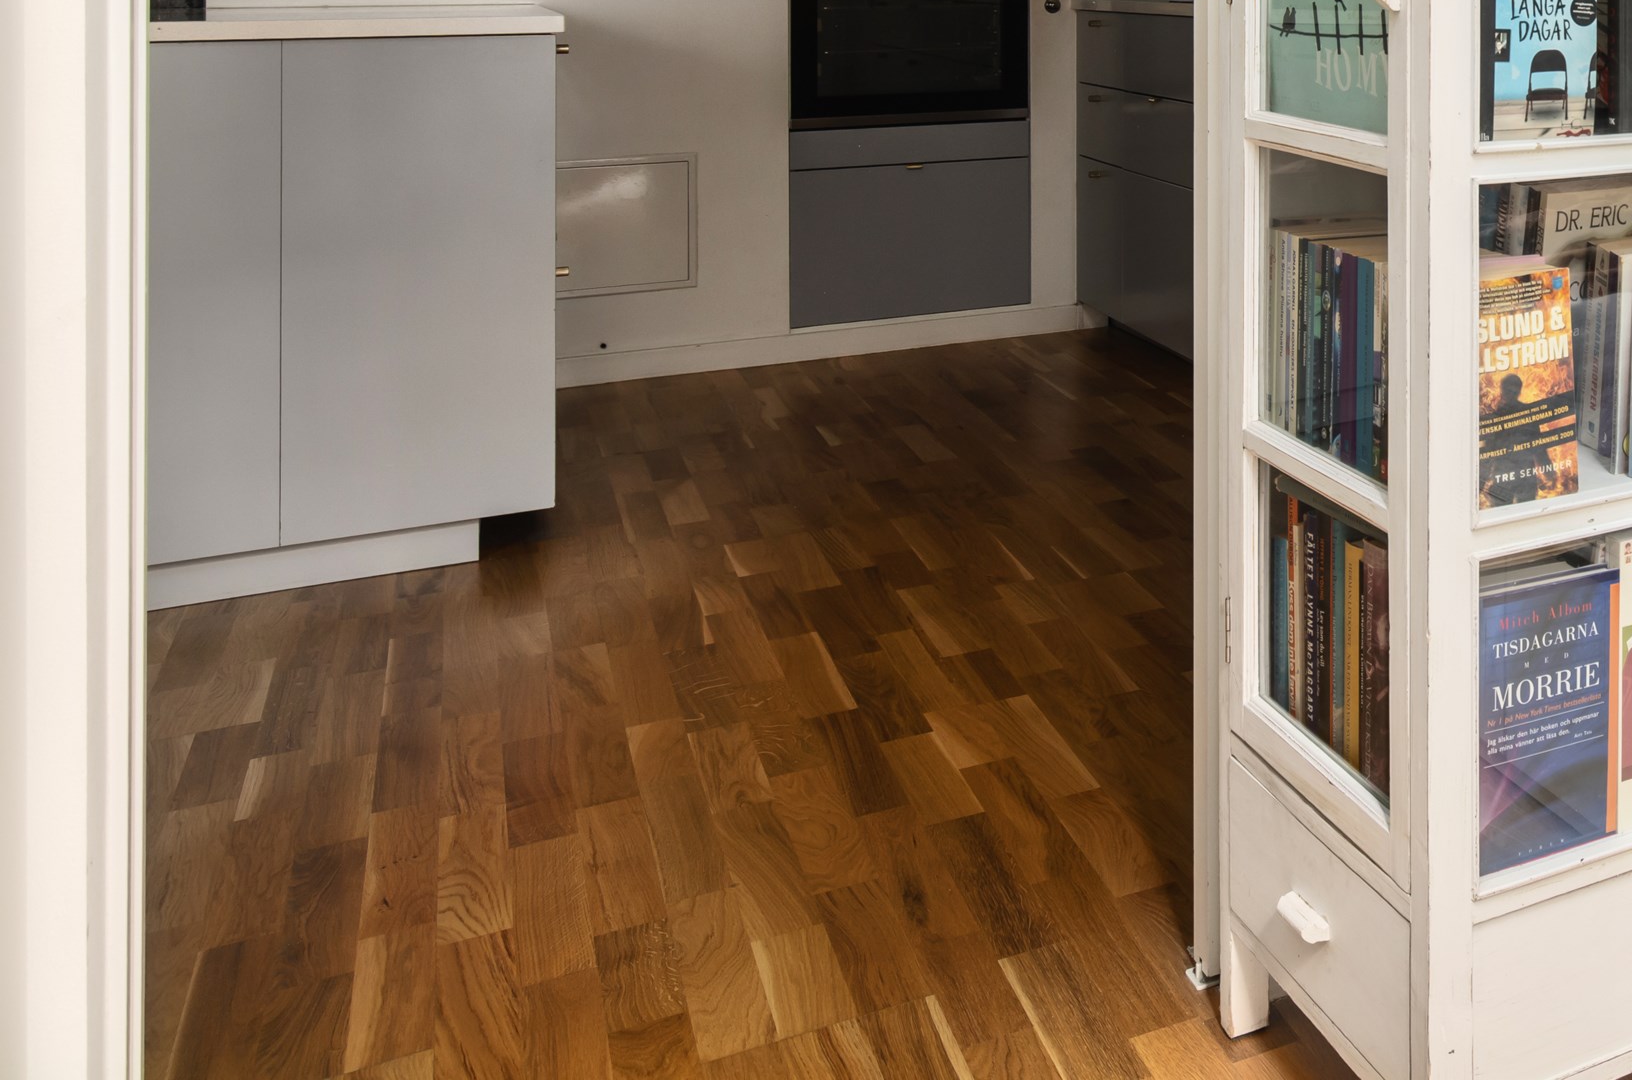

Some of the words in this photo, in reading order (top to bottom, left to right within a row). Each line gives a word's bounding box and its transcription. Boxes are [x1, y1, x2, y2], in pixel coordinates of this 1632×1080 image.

[1519, 18, 1572, 42] DAGAR
[1555, 209, 1583, 233] DR.
[1589, 203, 1629, 229] ERIC
[1479, 309, 1545, 345] SLUND
[1550, 305, 1566, 331] &
[1479, 333, 1569, 375] LSTRÖM
[1503, 410, 1553, 429] KRIMINALROMAN
[1554, 405, 1569, 415] 2009
[1479, 448, 1507, 460] ARPRISET
[1513, 442, 1531, 452] ÅRETS
[1532, 434, 1559, 447] SPÄNNING
[1560, 430, 1574, 439] 2009
[1494, 471, 1516, 483] TRE
[1519, 460, 1573, 478] SEKUNDER
[1307, 532, 1316, 580] FÄLTET
[1499, 610, 1540, 631] Mitch
[1550, 601, 1593, 619] Albom
[1492, 621, 1600, 660] TISDAGARNA
[1491, 661, 1601, 712] MORRIE
[1487, 719, 1496, 728] Nr
[1504, 715, 1514, 725] på
[1515, 712, 1529, 721] New
[1529, 708, 1543, 718] York
[1544, 704, 1562, 714] Times
[1563, 693, 1602, 709] bestsellerlista
[1487, 738, 1496, 748] Jag
[1498, 733, 1516, 744] älskar
[1516, 730, 1529, 739] den
[1529, 727, 1540, 736] här
[1540, 723, 1559, 733] boken
[1559, 718, 1571, 728] och
[1572, 711, 1600, 726] uppmanar
[1487, 747, 1498, 756] alla
[1499, 743, 1514, 753] mina
[1515, 738, 1535, 749] vänner
[1536, 735, 1545, 743] att
[1546, 732, 1557, 740] läsa
[1558, 728, 1570, 737] den.
